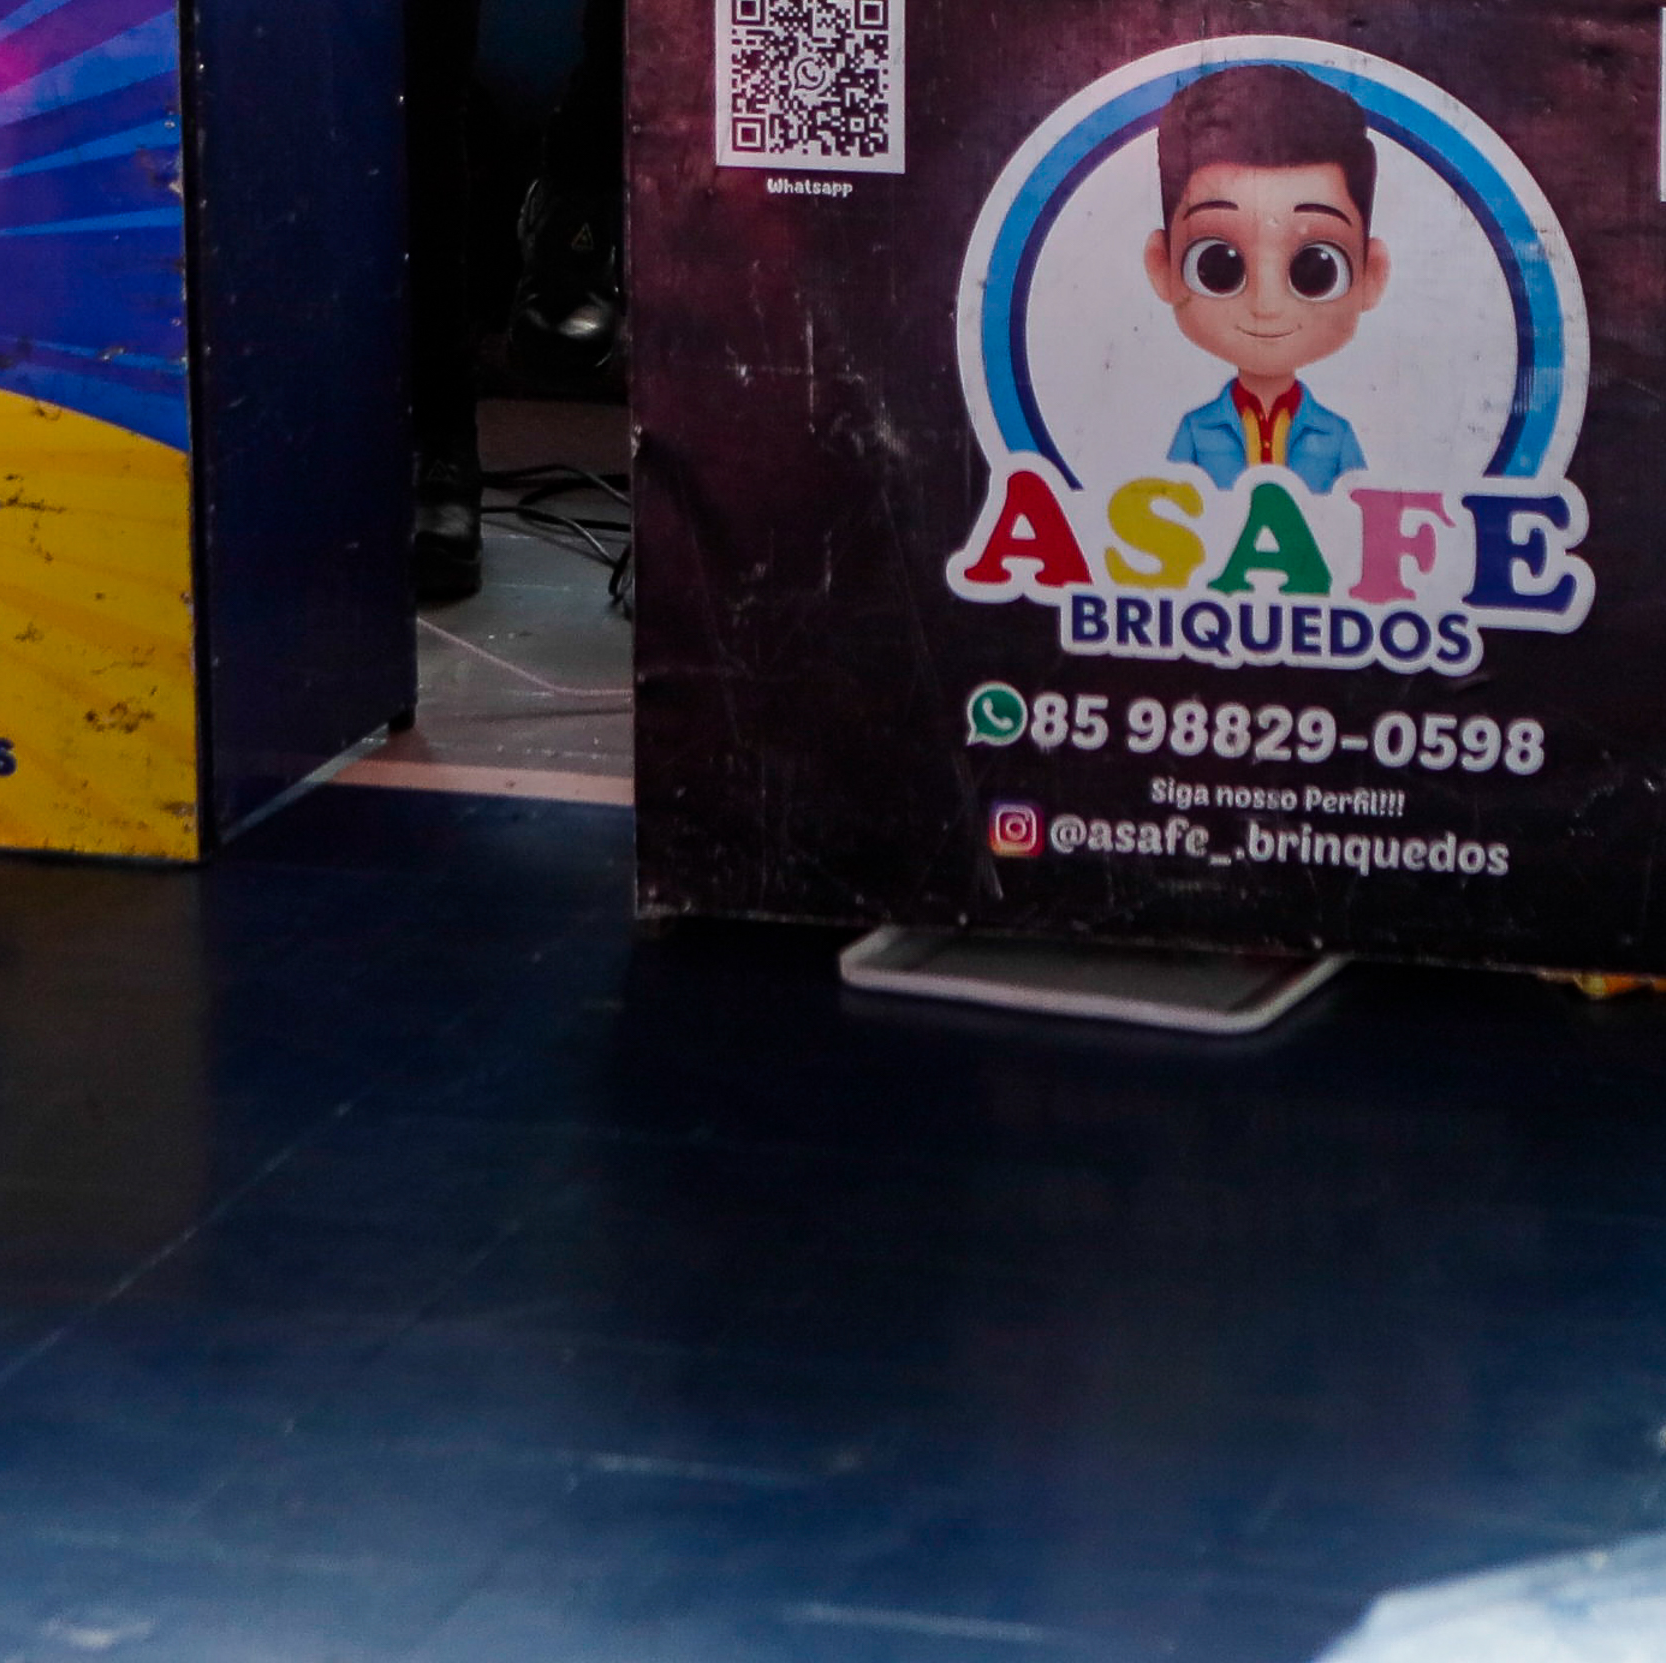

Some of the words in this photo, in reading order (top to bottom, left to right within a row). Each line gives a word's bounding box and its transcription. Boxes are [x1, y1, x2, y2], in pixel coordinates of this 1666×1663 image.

[766, 178, 853, 197] Whatsapp
[964, 470, 1579, 614] ASAFE
[1071, 594, 1472, 664] BRIQUEDOS
[1031, 693, 1109, 749] 85
[1127, 697, 1546, 775] 98829-0598
[1150, 777, 1210, 809] Siga
[1217, 784, 1298, 812] nosso
[1050, 815, 1510, 876] @asafe_.brinquedos
